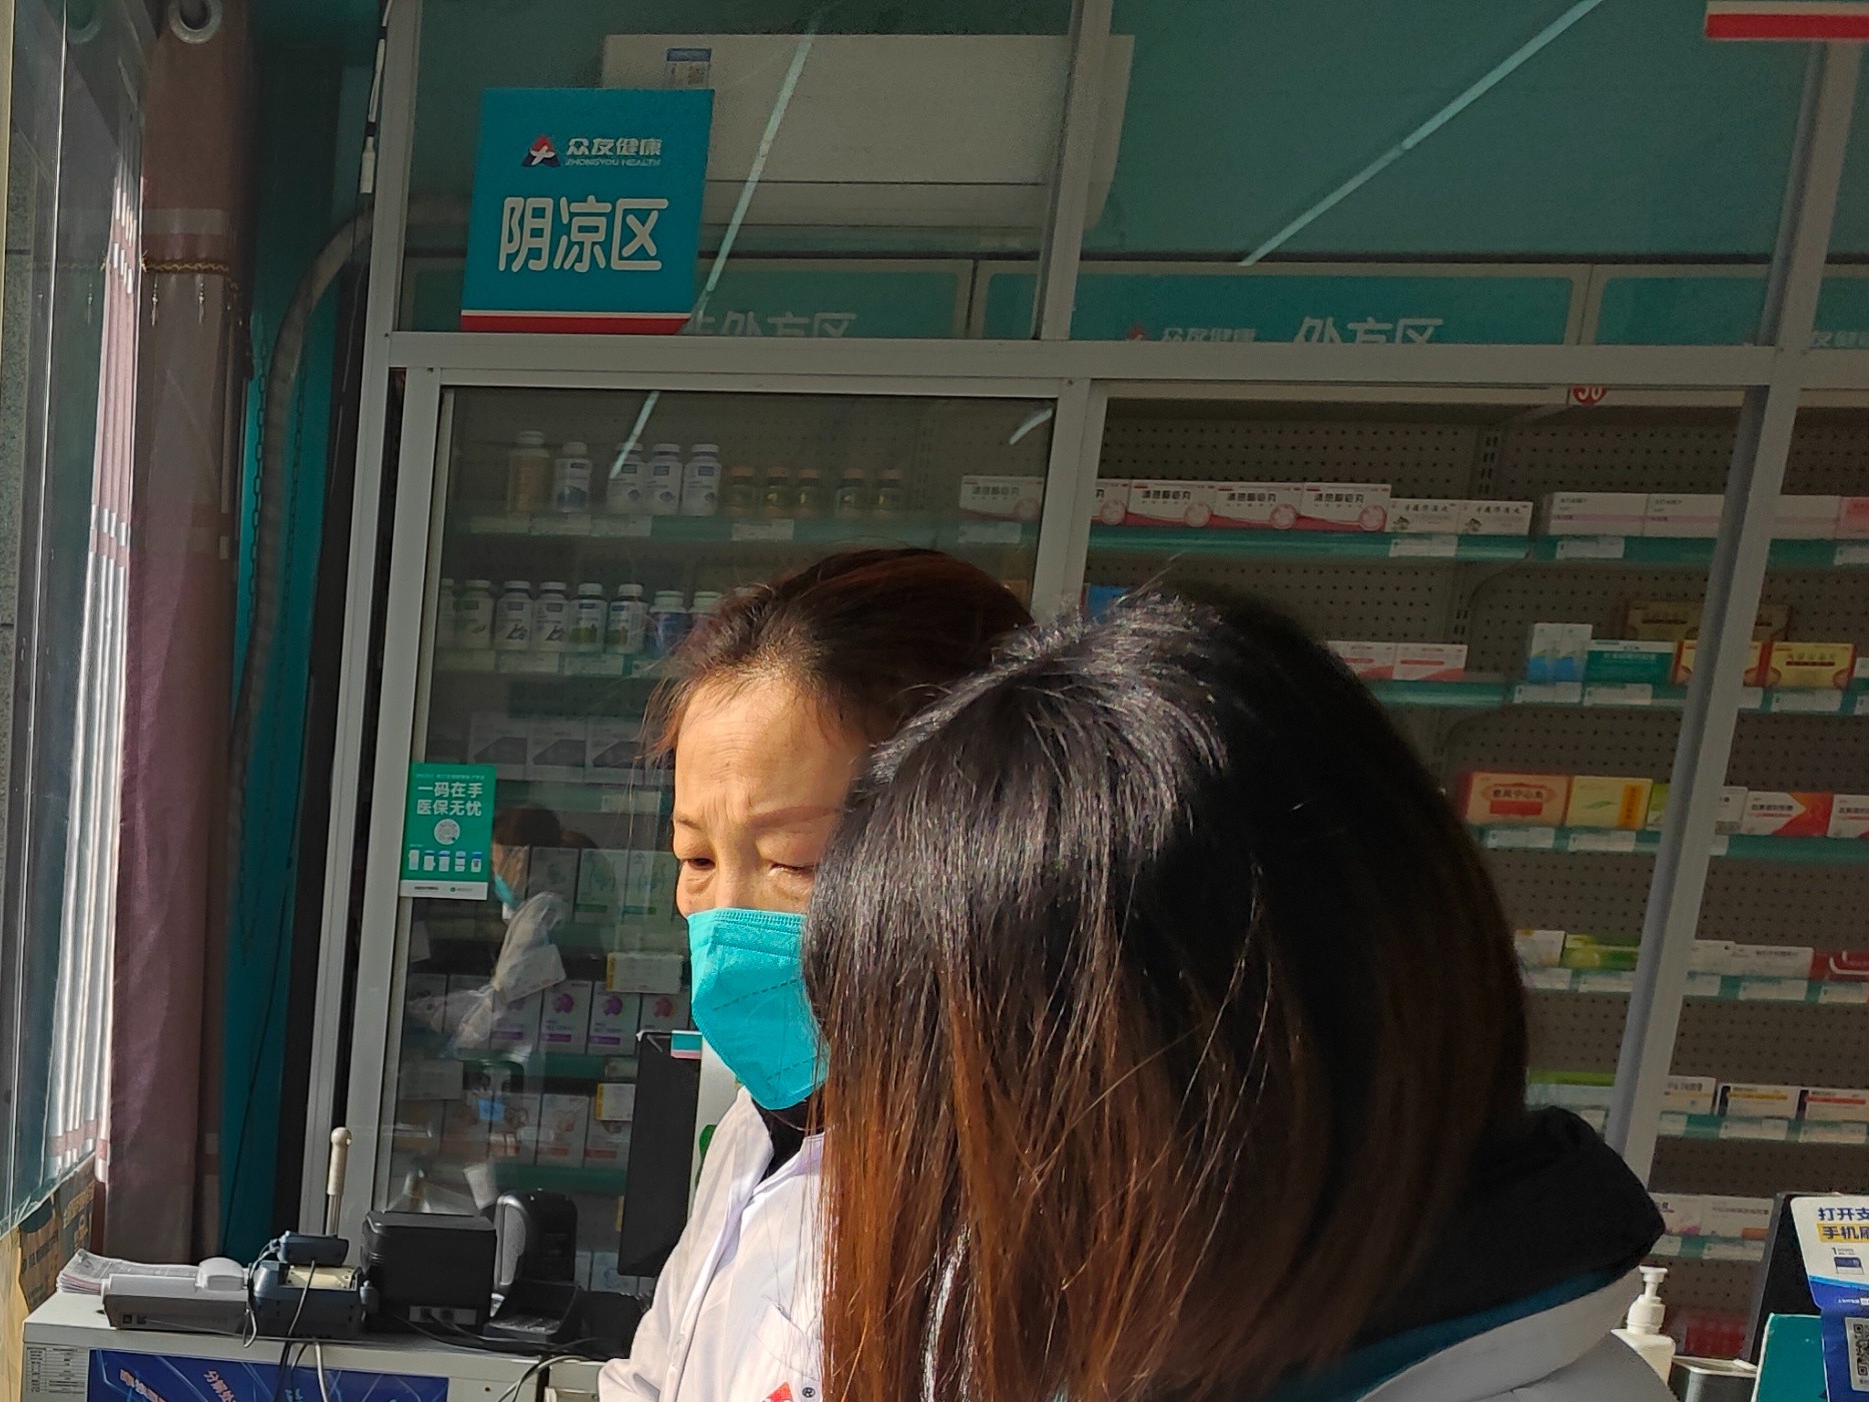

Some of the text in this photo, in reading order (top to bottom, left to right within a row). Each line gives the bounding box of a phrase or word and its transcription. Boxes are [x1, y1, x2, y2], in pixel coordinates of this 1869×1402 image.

[565, 137, 663, 157] 众友健康
[497, 194, 670, 274] 阴凉区
[417, 781, 483, 799] 一码在手
[416, 799, 483, 817] 医保无忧
